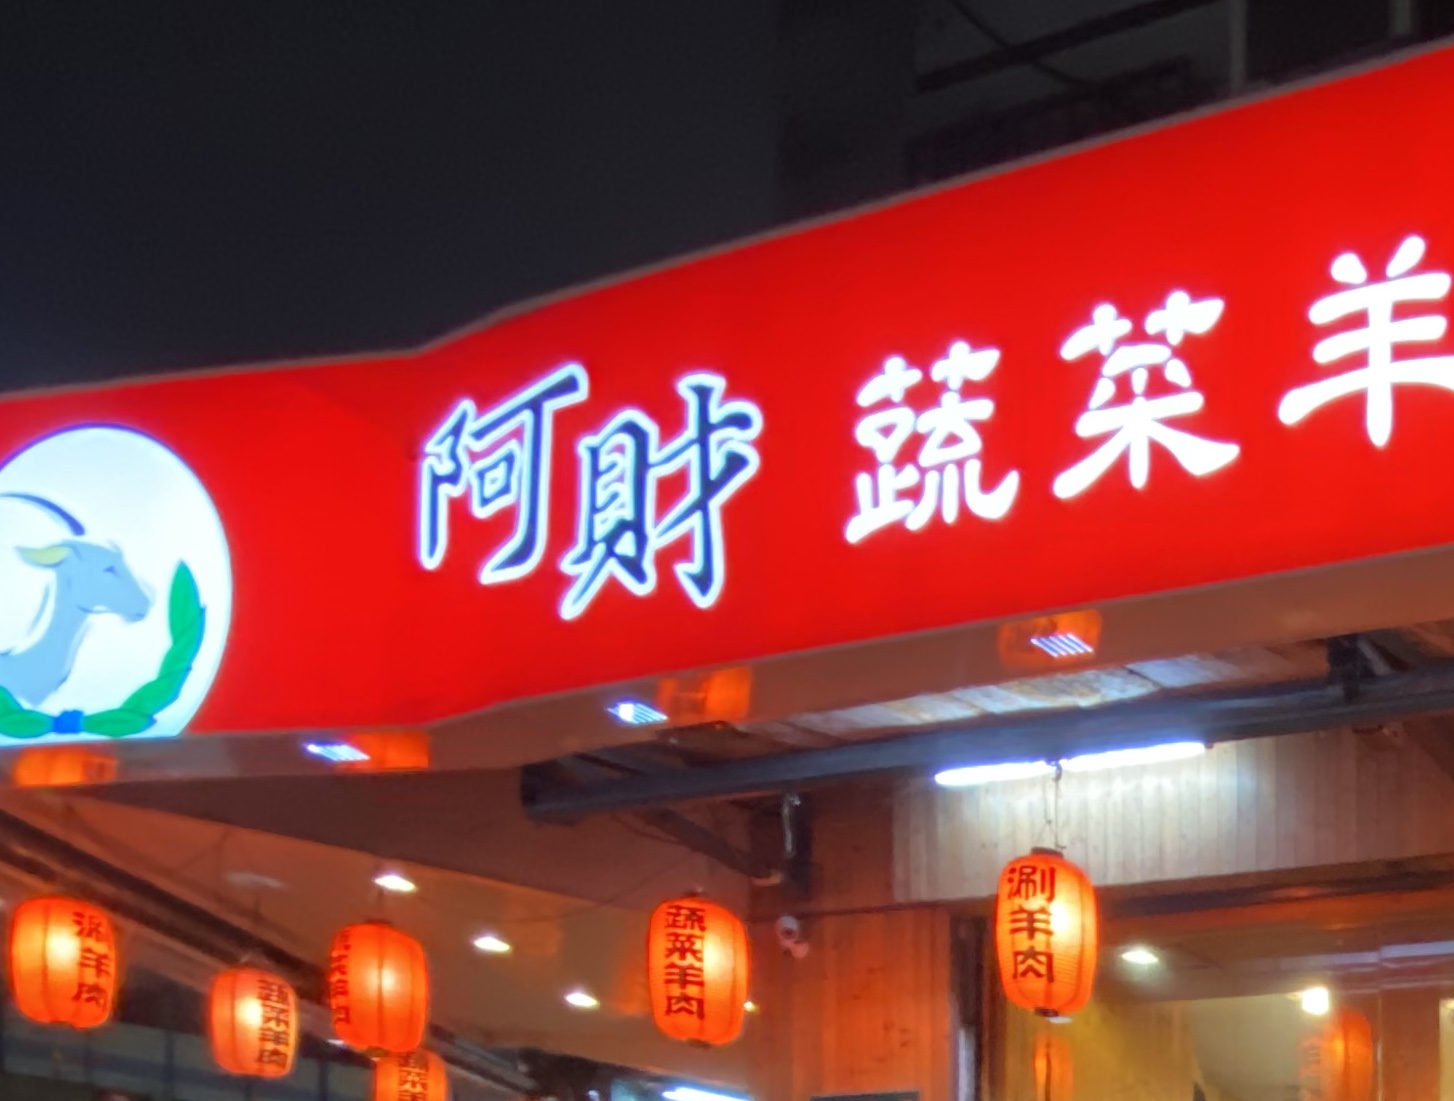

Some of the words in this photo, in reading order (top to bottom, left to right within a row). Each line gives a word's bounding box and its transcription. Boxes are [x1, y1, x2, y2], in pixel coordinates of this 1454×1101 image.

[418, 362, 765, 622] 阿財
[664, 904, 707, 1021] 蔬菜羊肉
[1007, 865, 1056, 984] 涮羊肉
[256, 979, 291, 1069] 蔬菜羊肉
